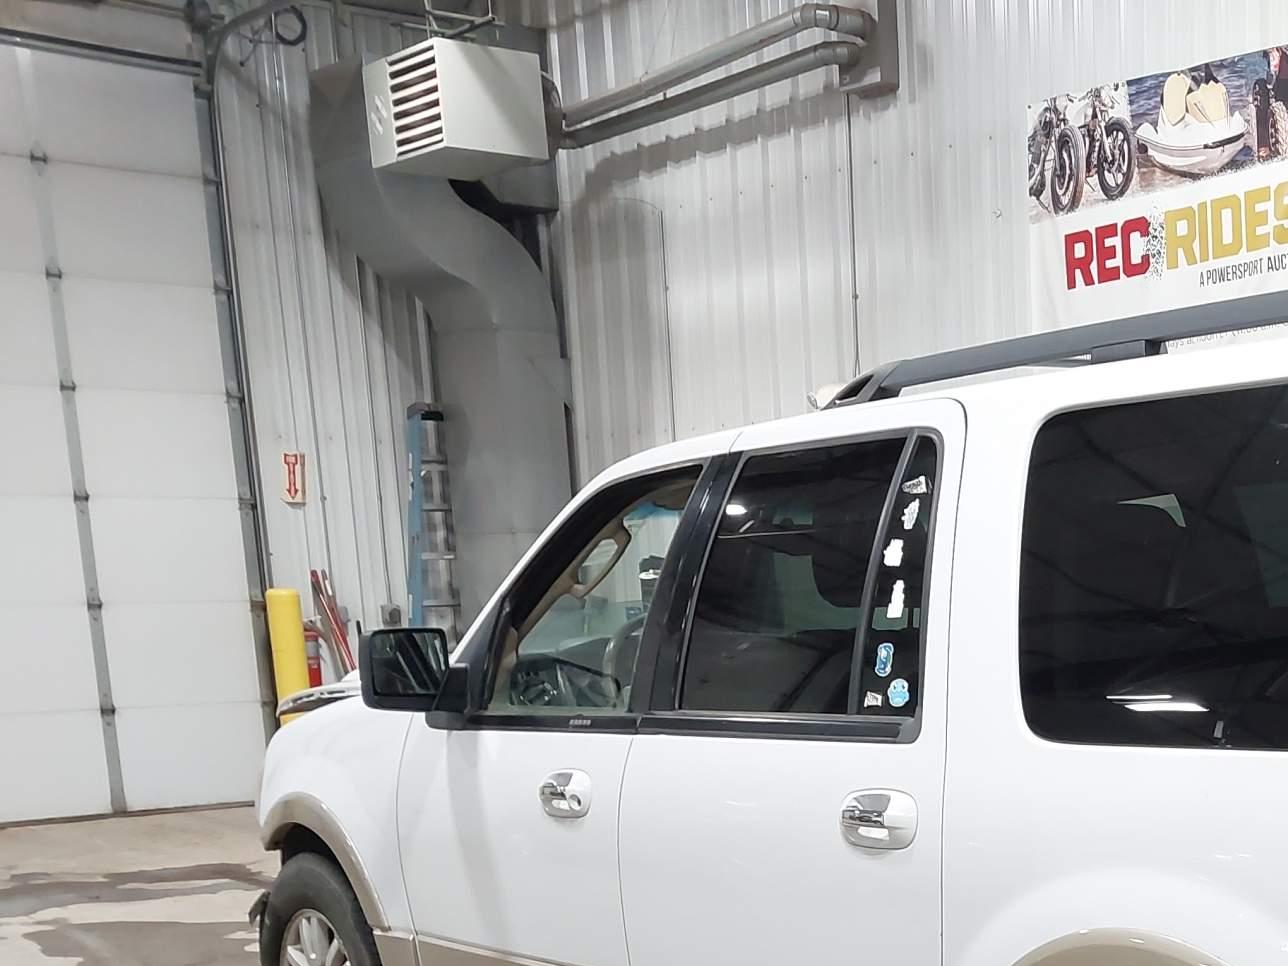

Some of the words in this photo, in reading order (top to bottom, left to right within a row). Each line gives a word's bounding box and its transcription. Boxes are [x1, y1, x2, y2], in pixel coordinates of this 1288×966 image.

[1064, 216, 1151, 290] REC
[1200, 271, 1206, 287] A
[1207, 258, 1263, 284] POWERSPORT
